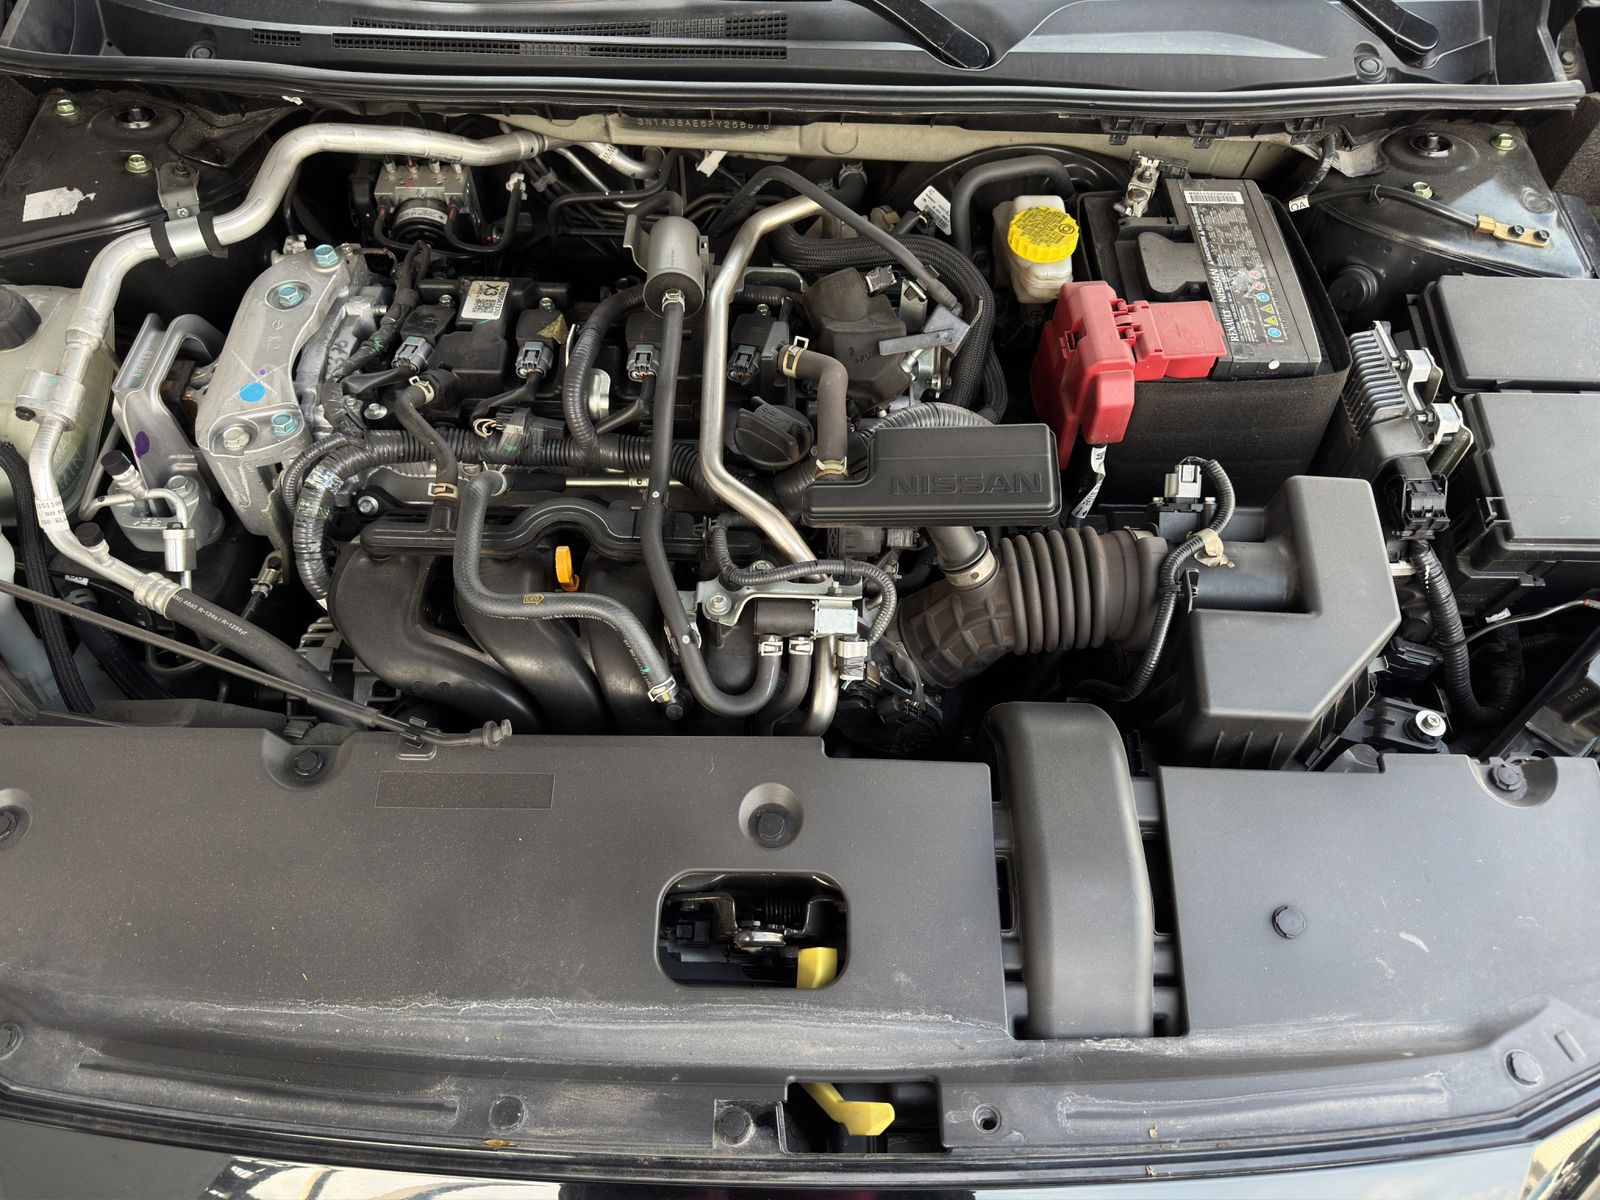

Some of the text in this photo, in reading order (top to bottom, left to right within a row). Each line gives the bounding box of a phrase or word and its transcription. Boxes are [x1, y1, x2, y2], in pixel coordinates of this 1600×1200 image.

[484, 284, 501, 297] X3
[1209, 268, 1227, 303] NISSAN
[1221, 308, 1239, 342] RENAULT
[892, 472, 1043, 496] NISSAN
[197, 607, 218, 621] R-134a
[221, 619, 249, 636] R-1234yf
